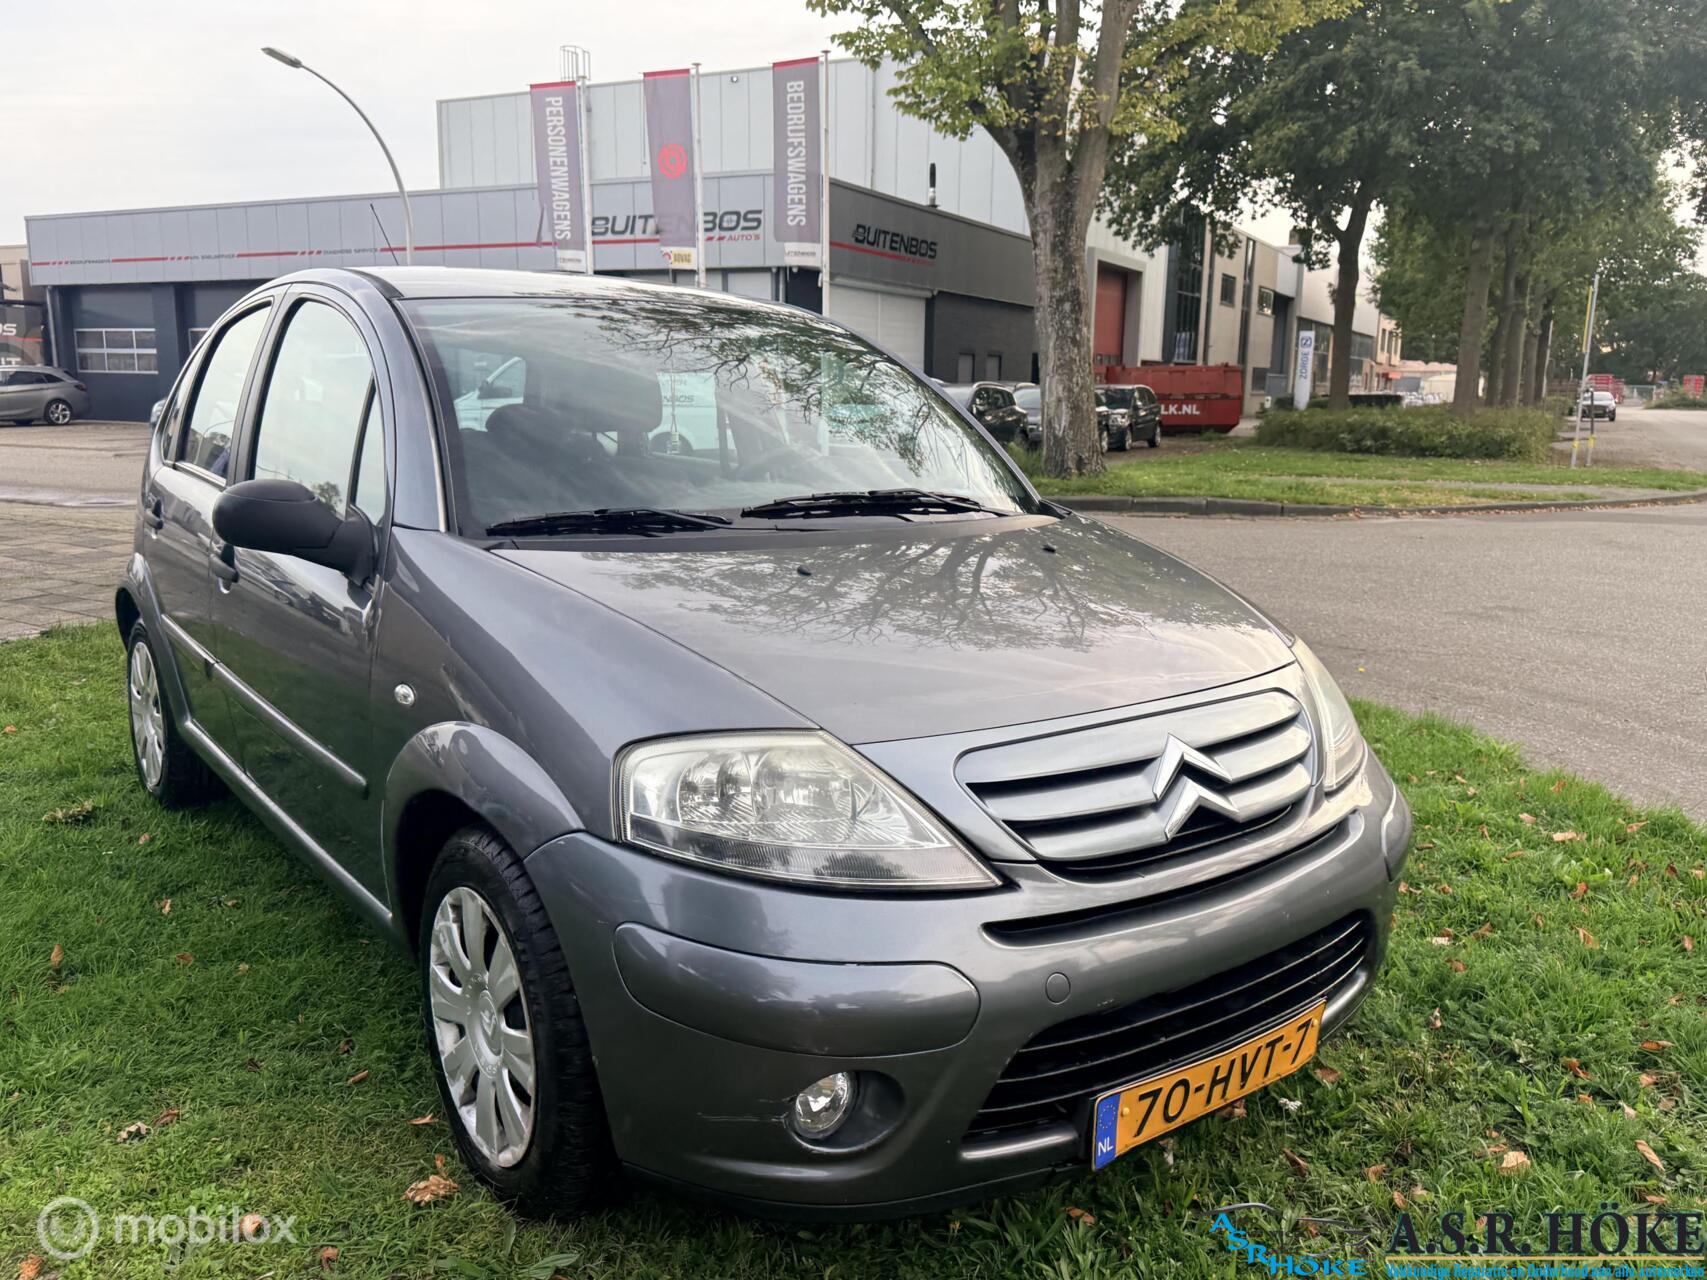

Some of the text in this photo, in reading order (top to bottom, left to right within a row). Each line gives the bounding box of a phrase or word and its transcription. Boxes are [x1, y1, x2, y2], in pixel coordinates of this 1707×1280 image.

[545, 96, 572, 241] PERSONENWAGENS
[786, 80, 806, 227] BEDRIJFSWAGENS
[854, 223, 938, 260] BUITENBOS
[1133, 1018, 1312, 1137] 70-HVT-7
[1098, 1137, 1113, 1155] NL
